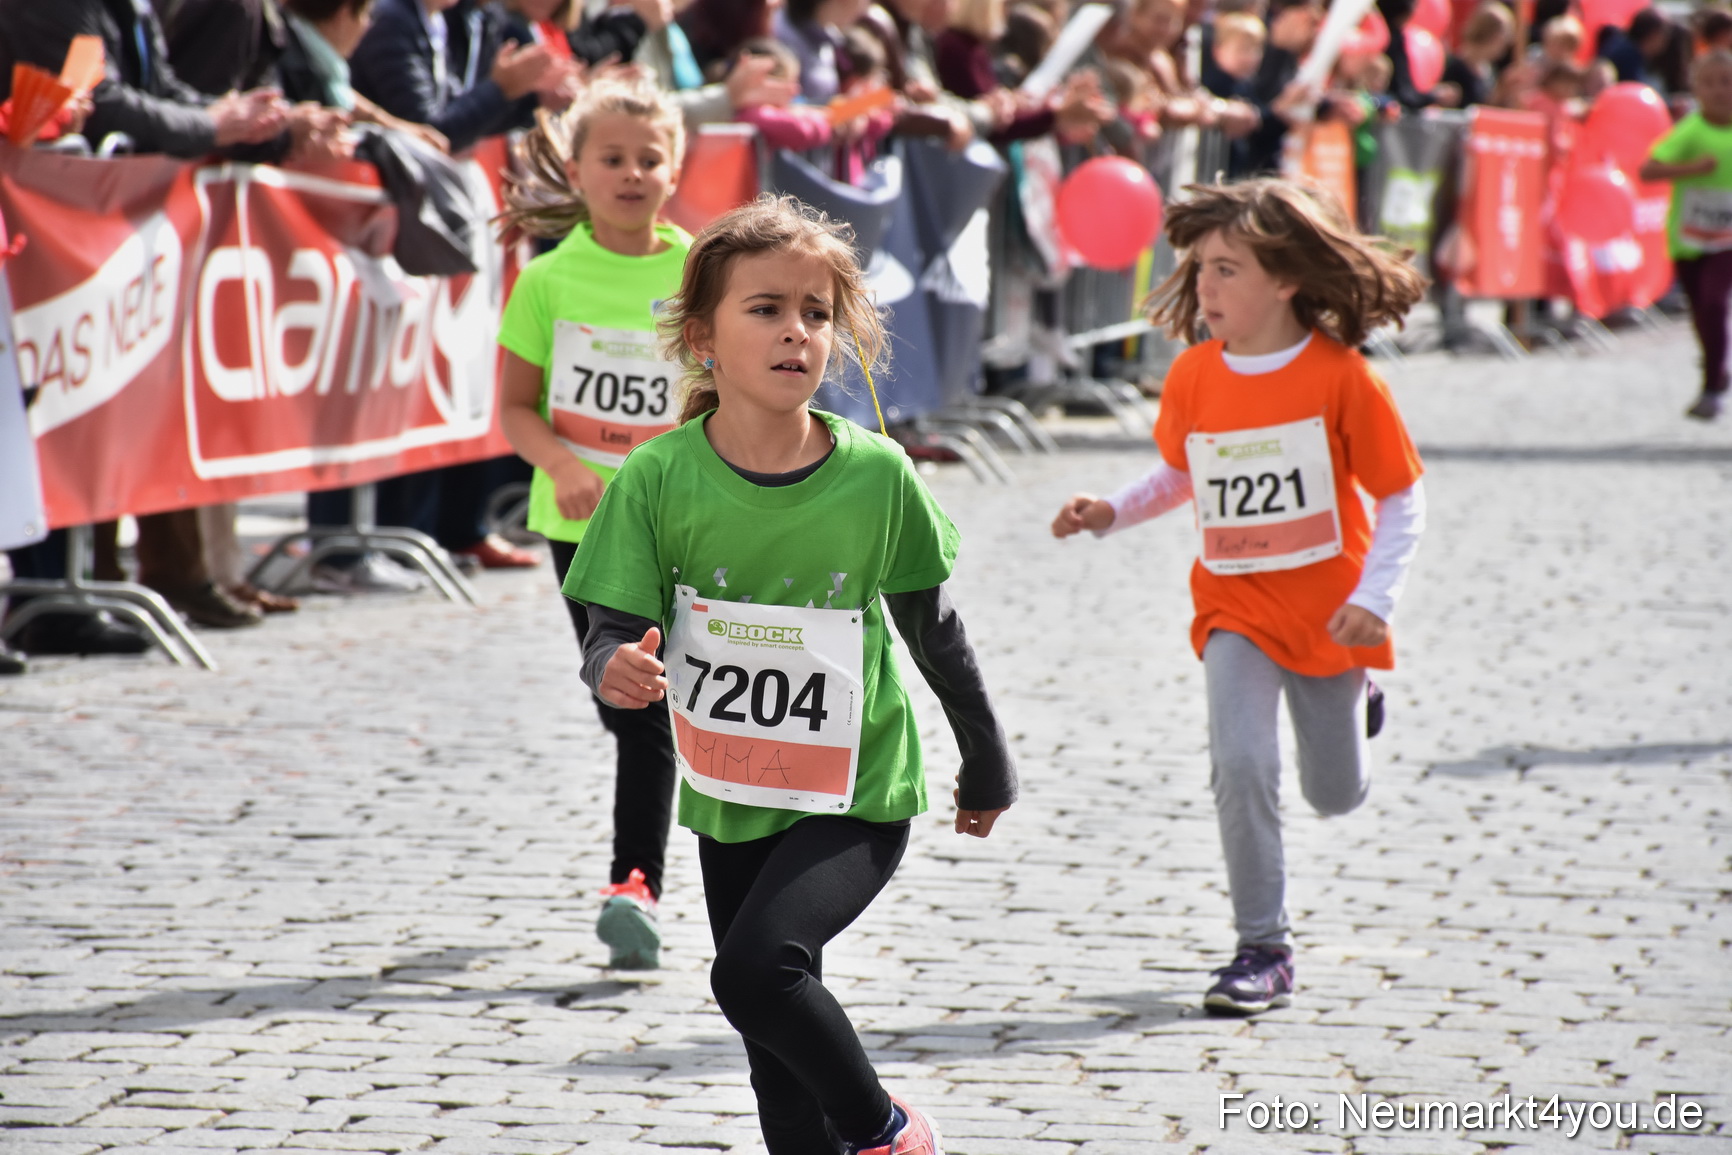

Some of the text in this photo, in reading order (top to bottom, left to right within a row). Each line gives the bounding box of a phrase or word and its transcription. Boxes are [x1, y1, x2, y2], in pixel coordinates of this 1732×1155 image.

[573, 364, 668, 417] 7053
[1207, 467, 1306, 518] 7221
[727, 639, 750, 647] inspired
[728, 622, 803, 644] BOCK
[685, 653, 828, 732] 7204
